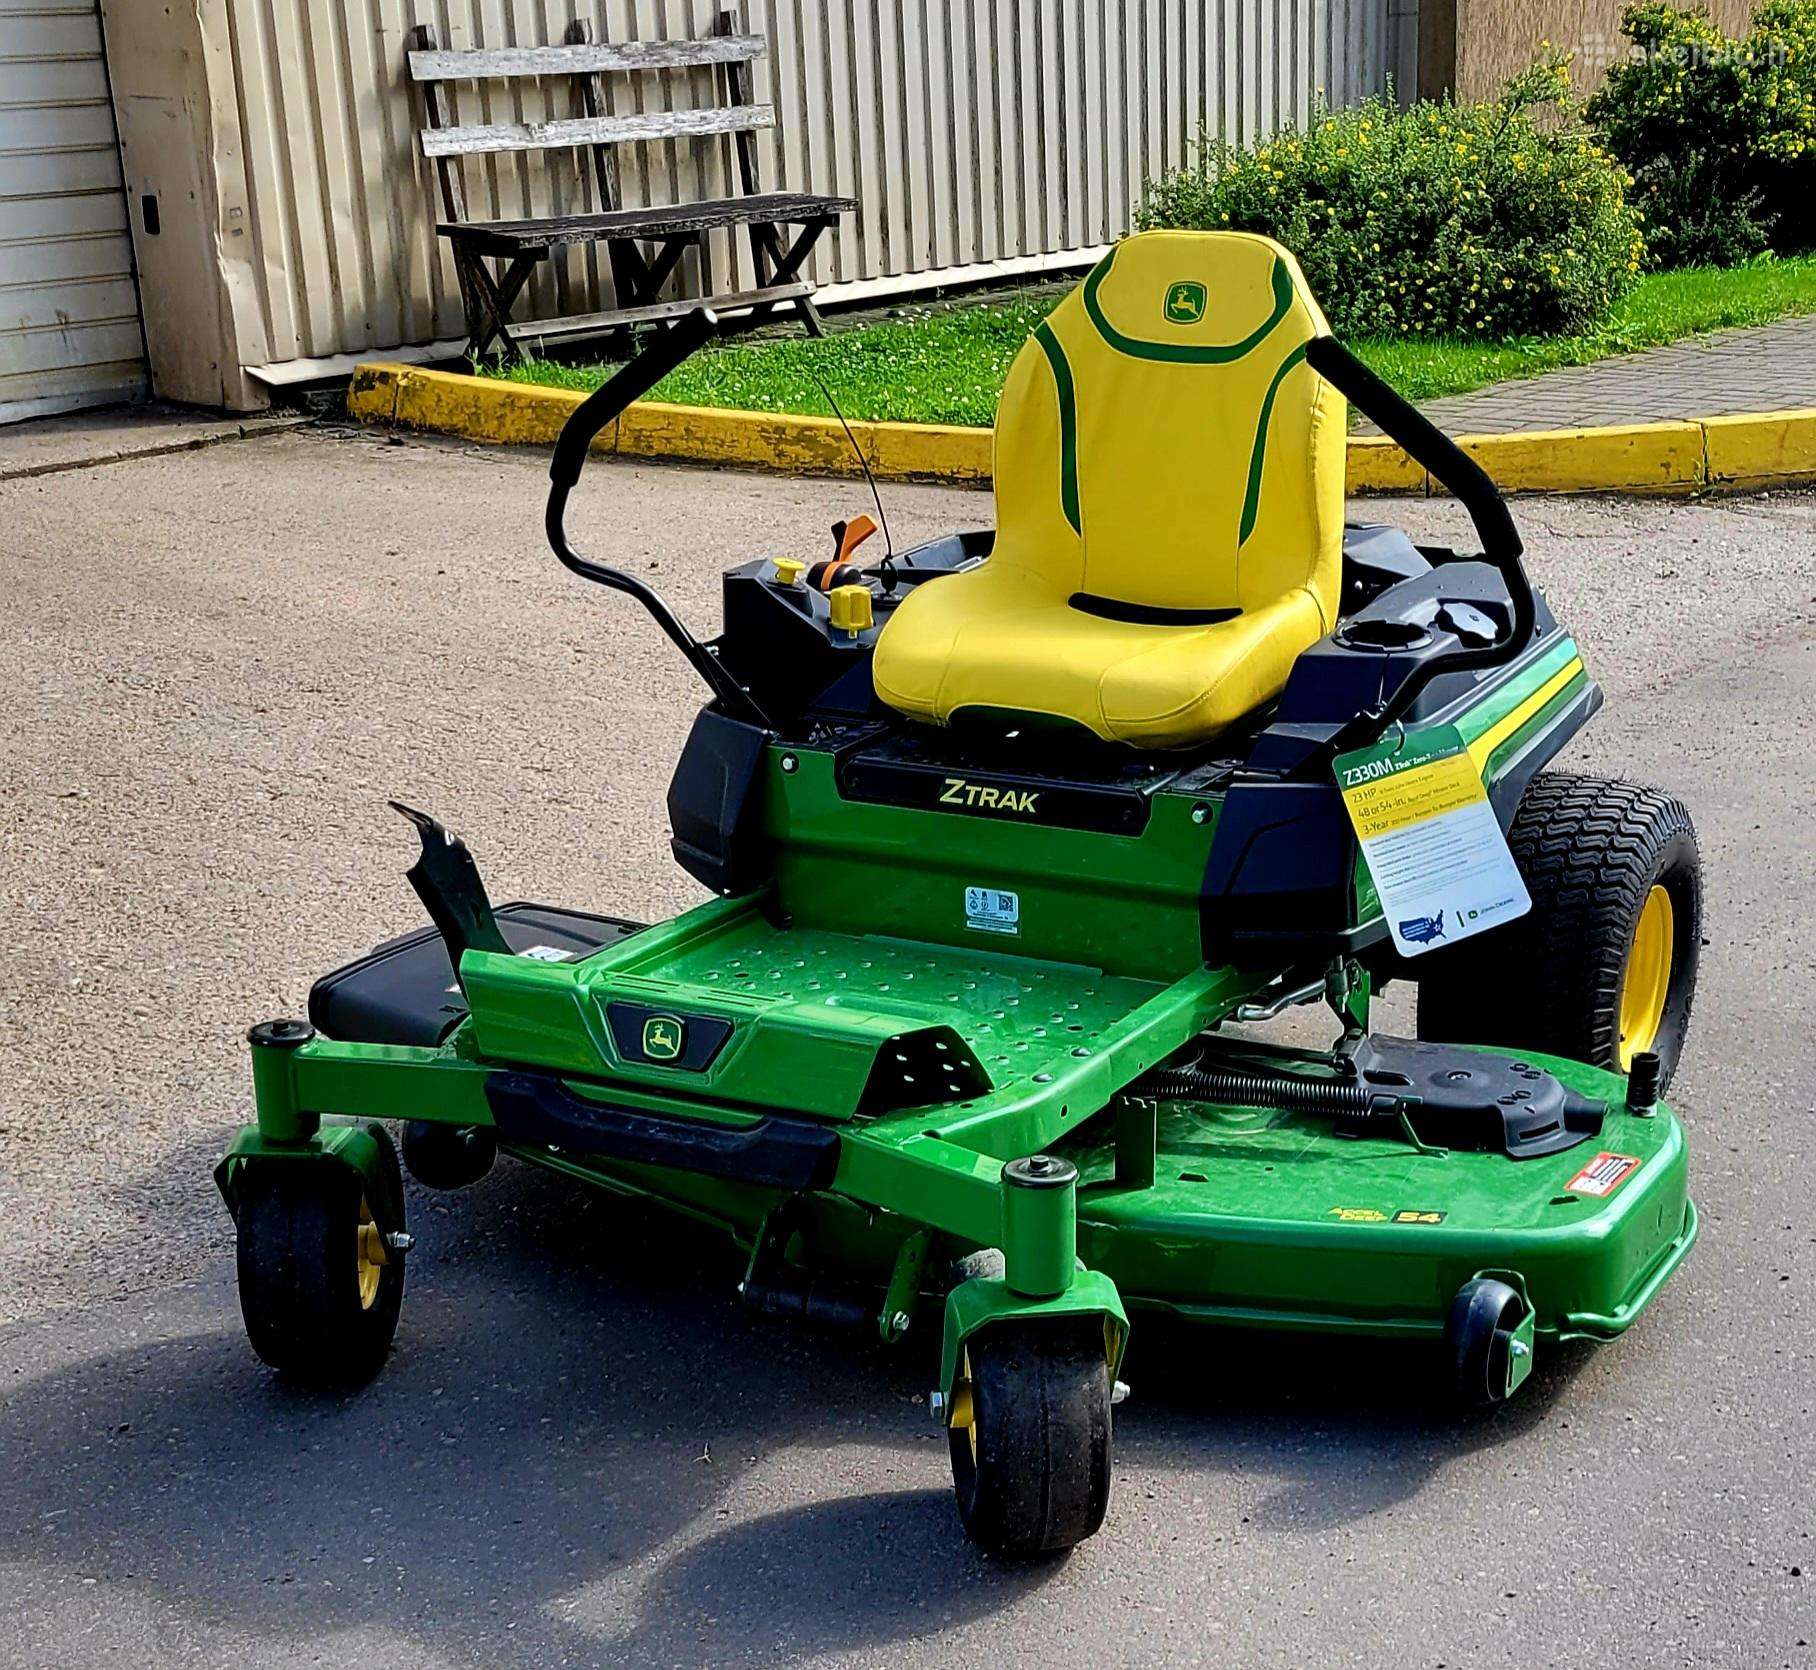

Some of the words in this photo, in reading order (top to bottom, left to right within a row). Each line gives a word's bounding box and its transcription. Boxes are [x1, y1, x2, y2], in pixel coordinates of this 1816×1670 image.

[1343, 758, 1394, 786] Z330M
[940, 778, 1040, 813] ZTRAK
[1352, 792, 1363, 804] 23
[1363, 788, 1377, 799] HP
[1358, 808, 1370, 818] 48
[1371, 807, 1380, 815] or
[1363, 820, 1389, 834] 3-Year
[1397, 1211, 1441, 1223] 54
